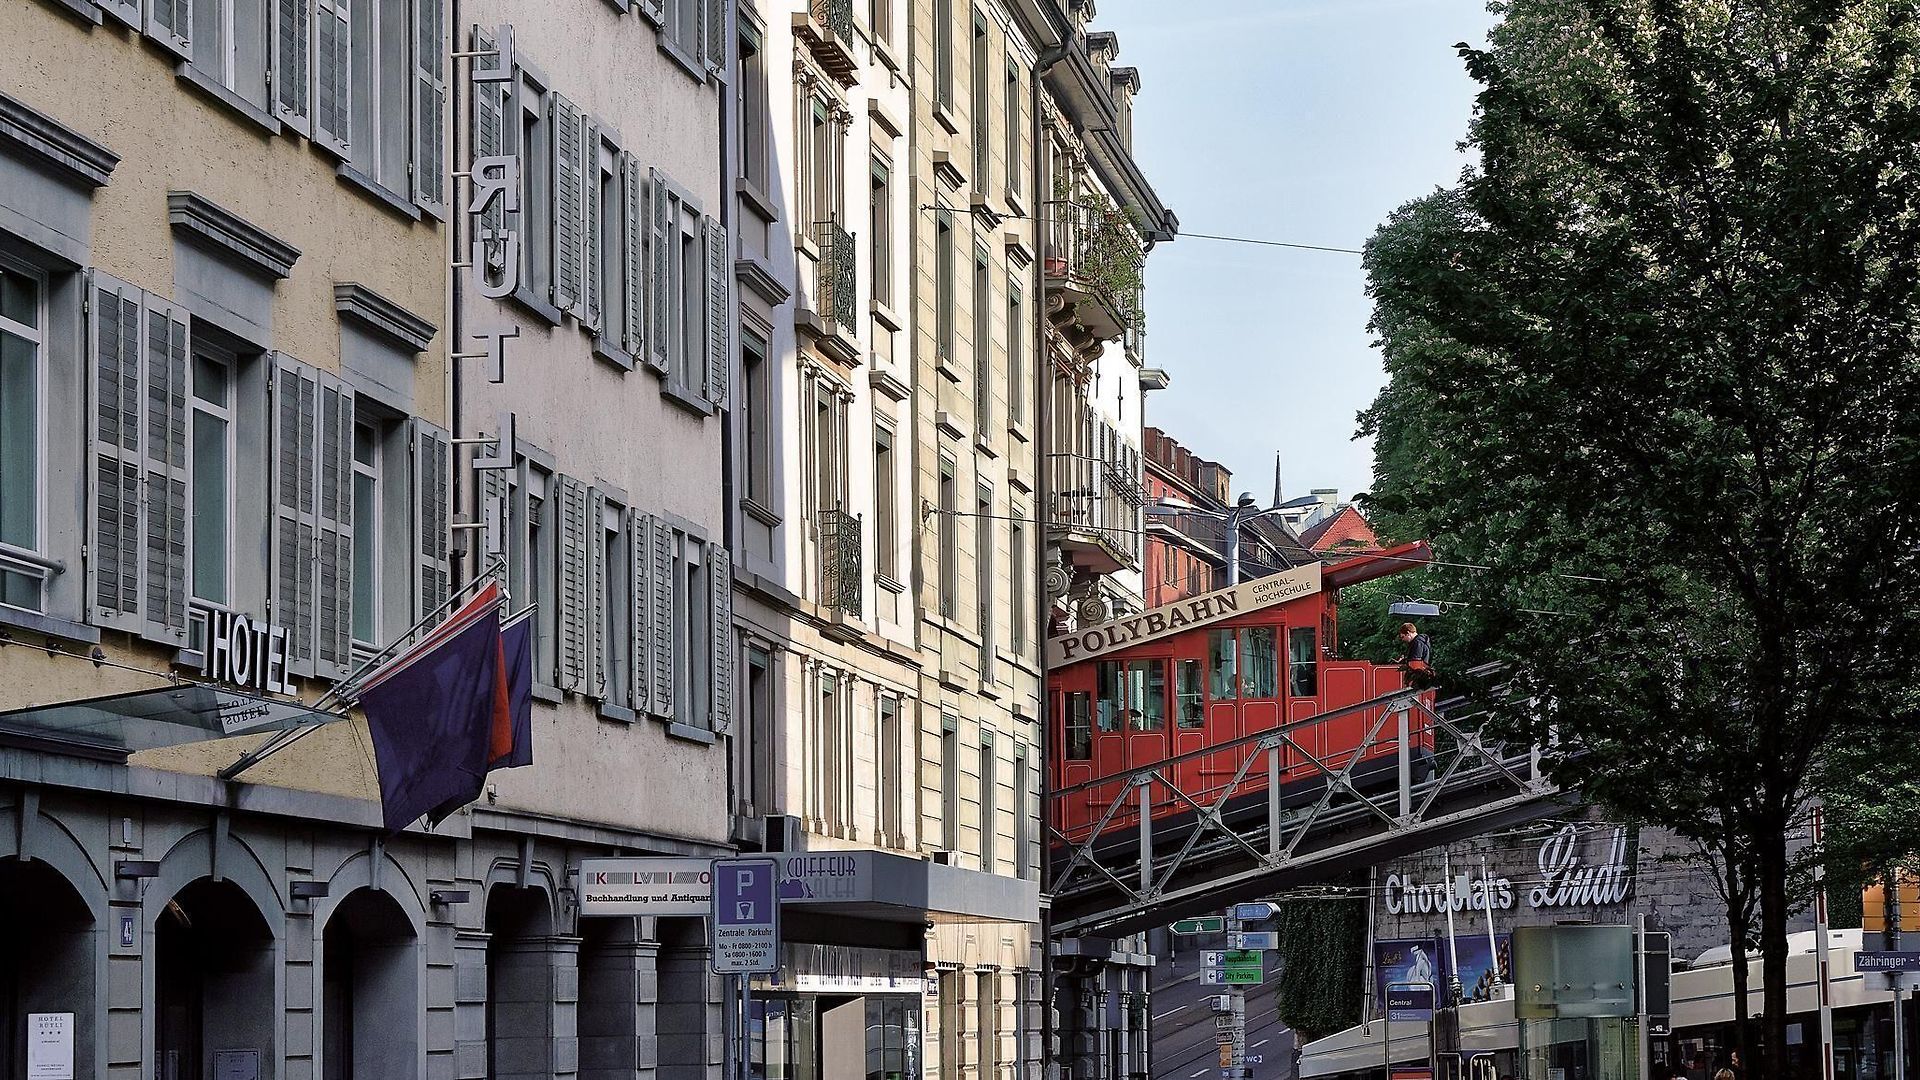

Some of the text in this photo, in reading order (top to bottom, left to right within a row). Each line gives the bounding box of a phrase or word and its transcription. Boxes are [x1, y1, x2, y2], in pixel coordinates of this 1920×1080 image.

[1254, 582, 1311, 604] HOCHSCHULE
[1059, 590, 1240, 660] POLYBAHN
[213, 610, 297, 696] HOTEL
[787, 856, 856, 878] COIFFEUR
[1529, 824, 1630, 908] Lindt
[737, 870, 754, 896] P
[586, 894, 648, 904] Buchhandlung
[671, 894, 712, 903] Antiquar
[718, 929, 744, 937] Zentrale
[1859, 956, 1906, 968] Zähringer
